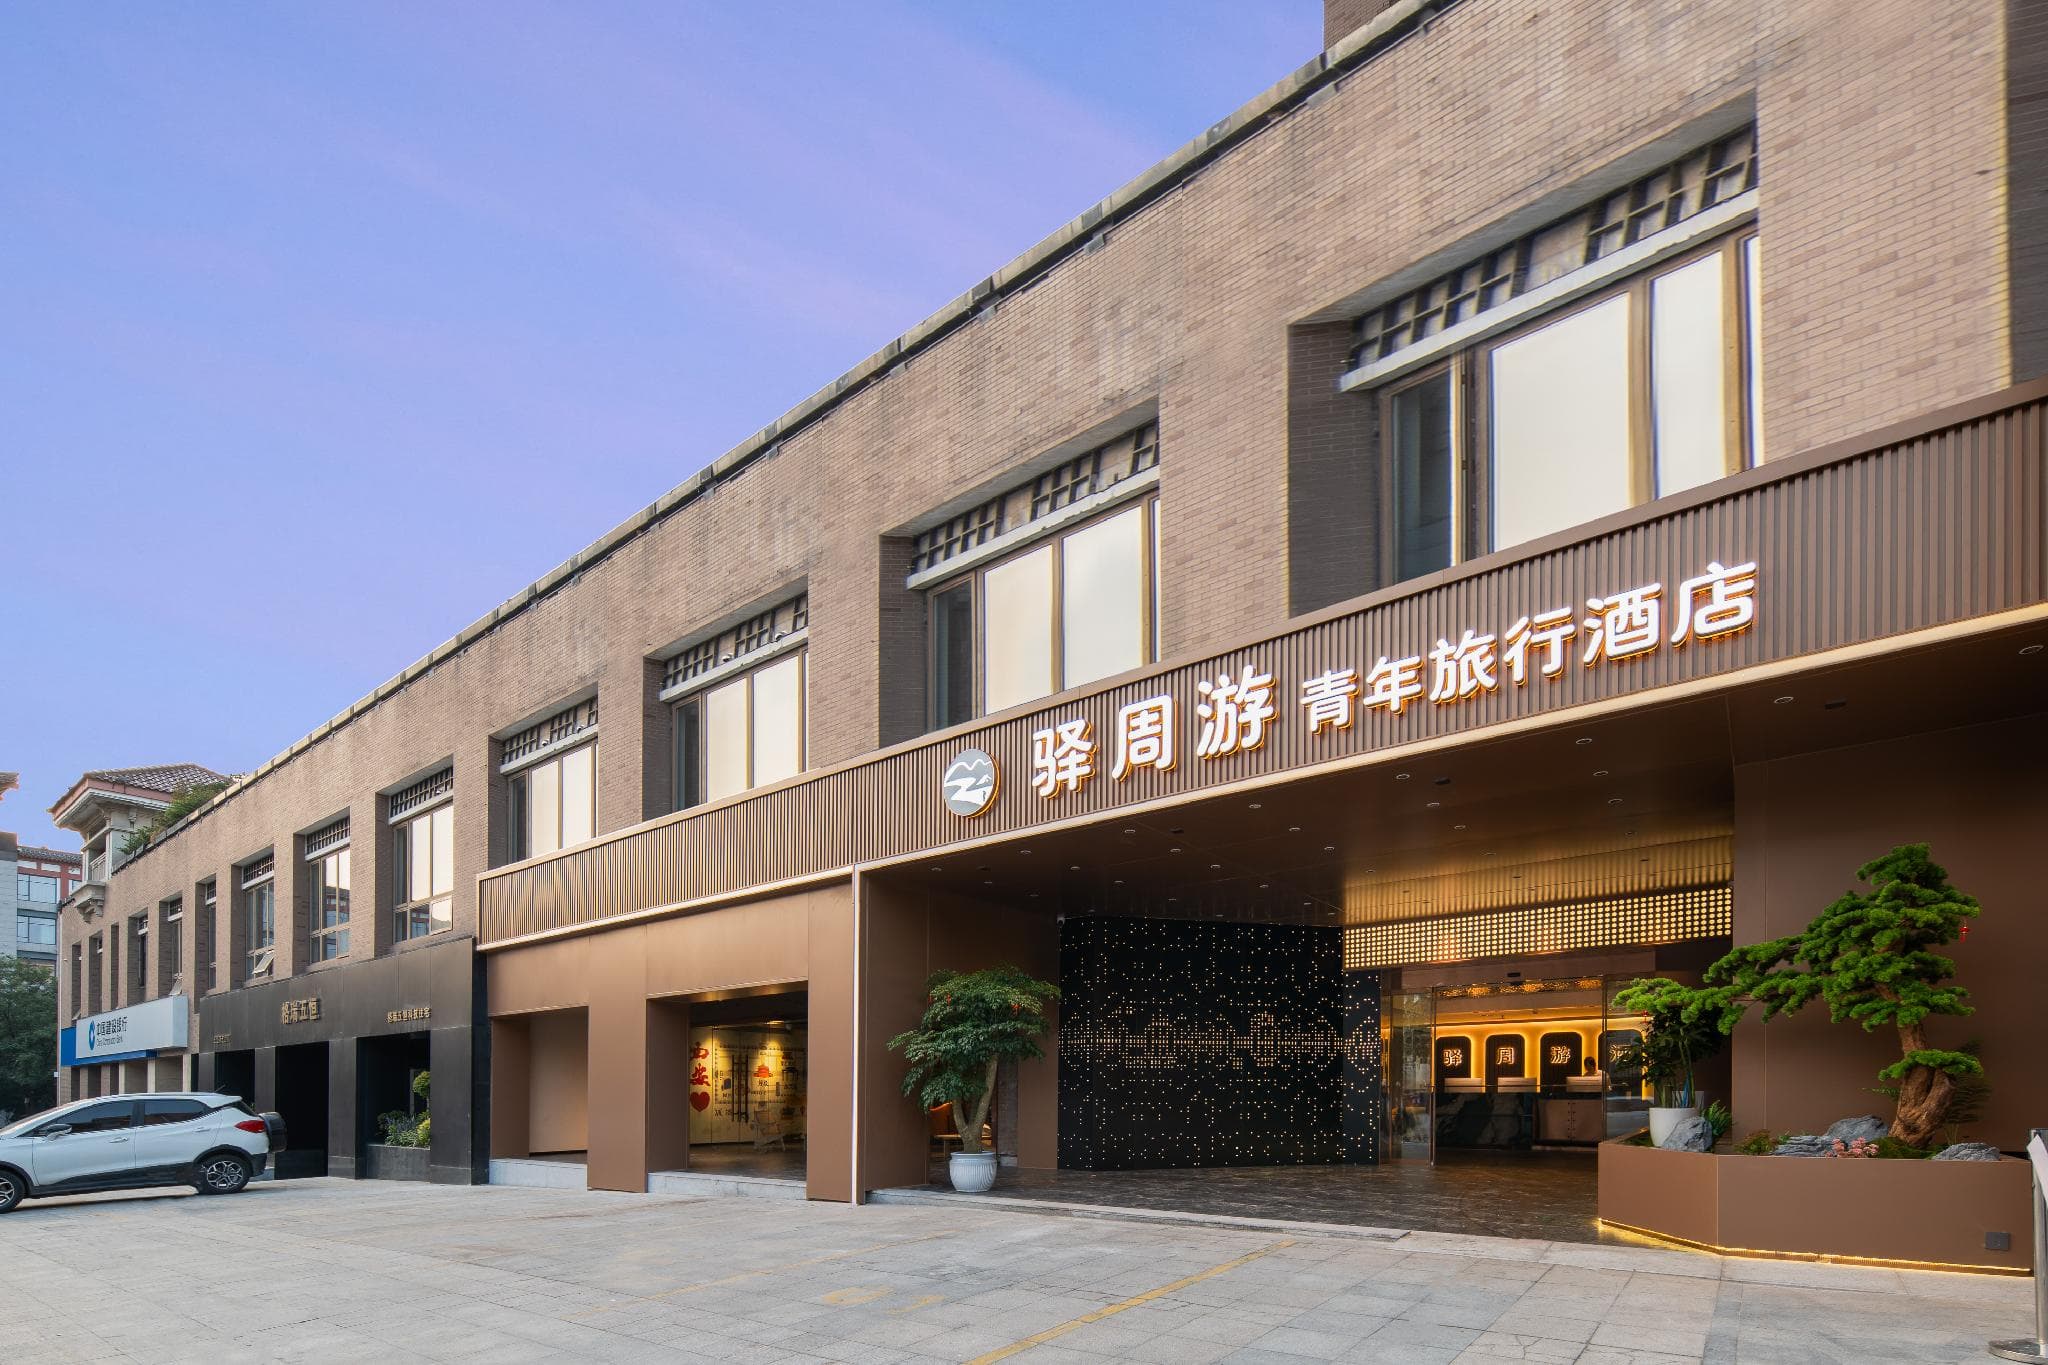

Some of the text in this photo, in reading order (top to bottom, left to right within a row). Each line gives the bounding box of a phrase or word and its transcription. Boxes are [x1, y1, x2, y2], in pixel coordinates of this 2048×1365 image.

[1031, 561, 1757, 800] 驿周游 青年旅行酒店
